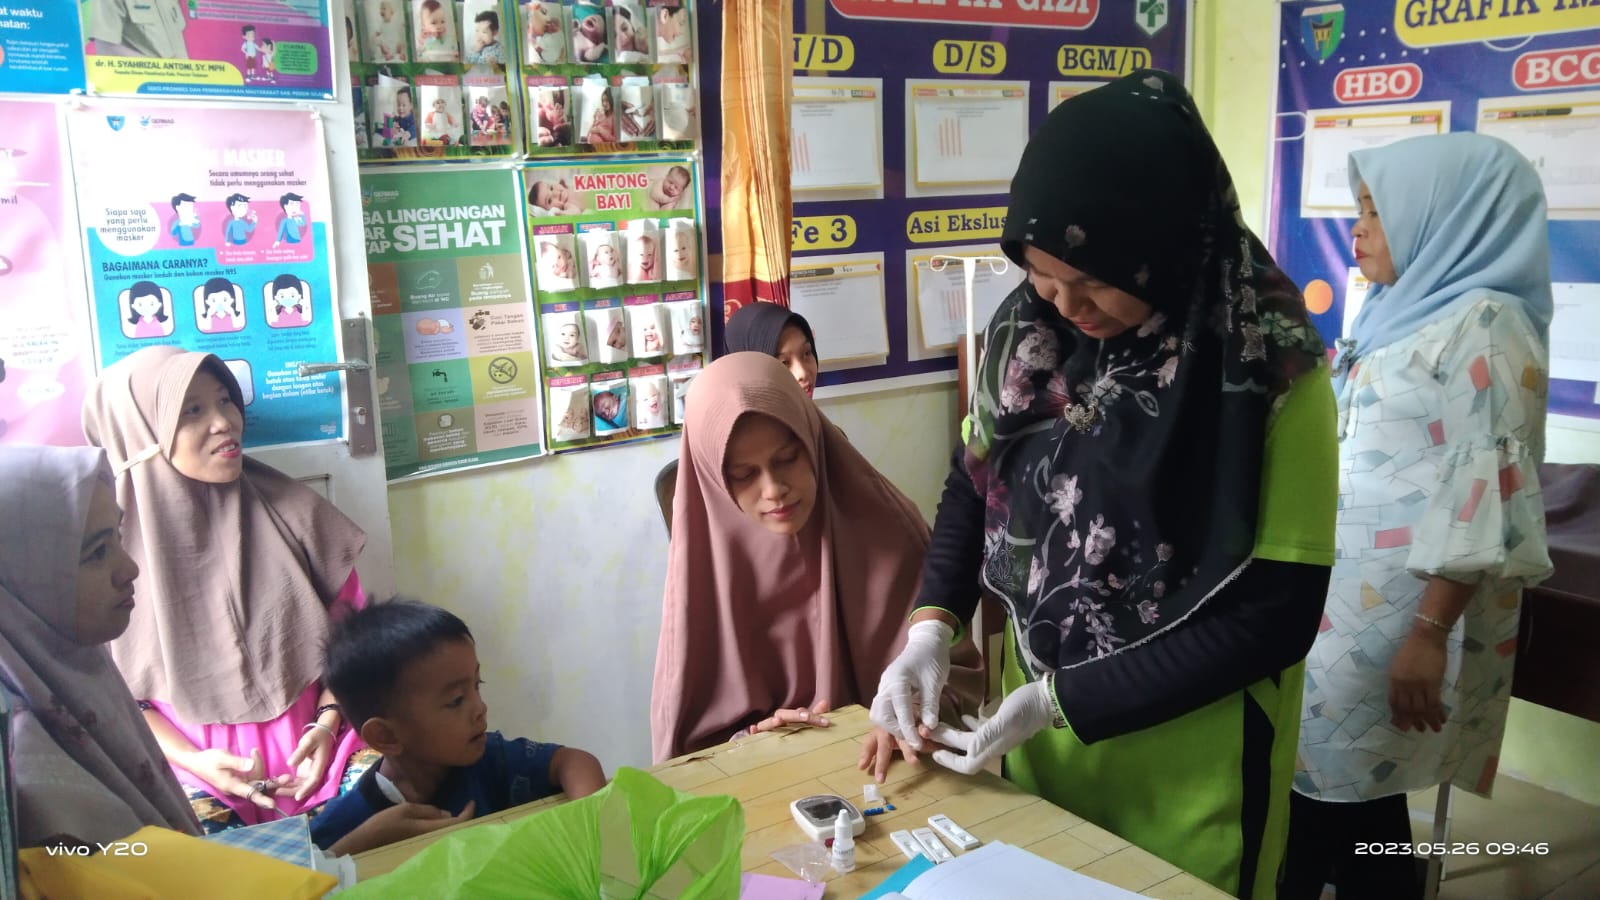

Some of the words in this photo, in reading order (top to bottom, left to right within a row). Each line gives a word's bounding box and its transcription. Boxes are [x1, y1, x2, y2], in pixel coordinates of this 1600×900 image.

[10, 8, 44, 18] waktu
[943, 42, 996, 71] D/S
[1062, 47, 1147, 75] BGM/D
[1525, 52, 1600, 85] BCG
[1342, 69, 1412, 98] HBO
[208, 169, 229, 177] Secara
[574, 173, 648, 191] KANTONG
[597, 194, 631, 209] BAYI
[105, 208, 128, 217] Siapa
[130, 208, 146, 218] saja
[106, 218, 126, 226] yang
[128, 217, 148, 226] perlu
[387, 204, 506, 223] LINGKUNGAN
[100, 226, 156, 236] menggunakan
[831, 218, 847, 242] 3
[909, 215, 940, 234] Asi
[116, 234, 144, 242] masker
[393, 220, 507, 253] SEHAT
[102, 260, 160, 272] BAGAIMANA
[162, 258, 208, 269] CARANYA?
